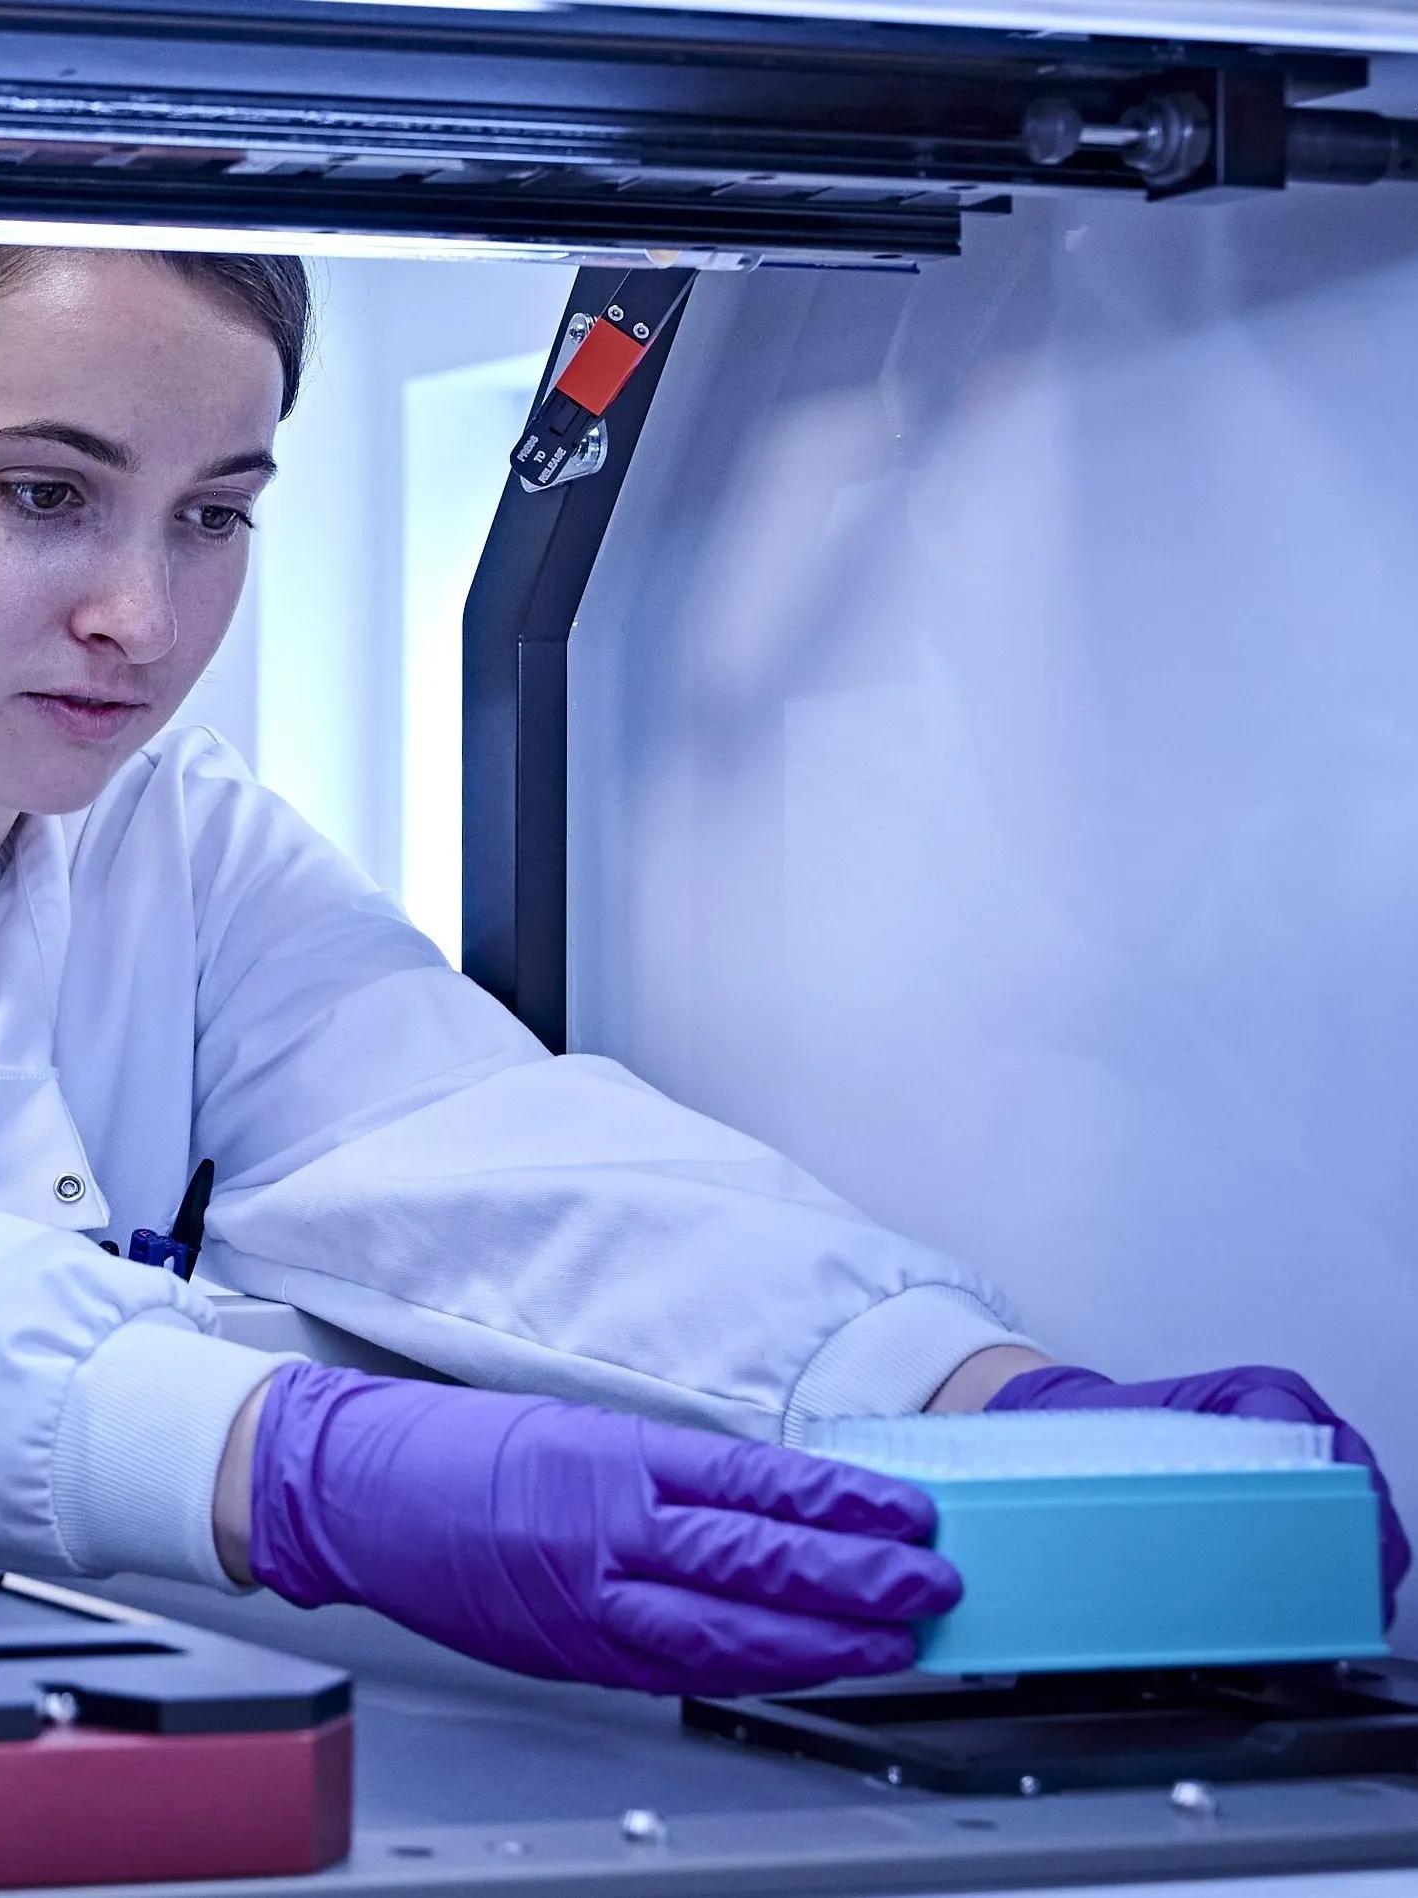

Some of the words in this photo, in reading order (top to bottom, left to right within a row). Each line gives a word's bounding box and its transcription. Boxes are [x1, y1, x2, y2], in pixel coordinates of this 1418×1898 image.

[517, 435, 538, 462] PRESS
[533, 450, 546, 463] TO
[538, 447, 566, 483] RELEASE
